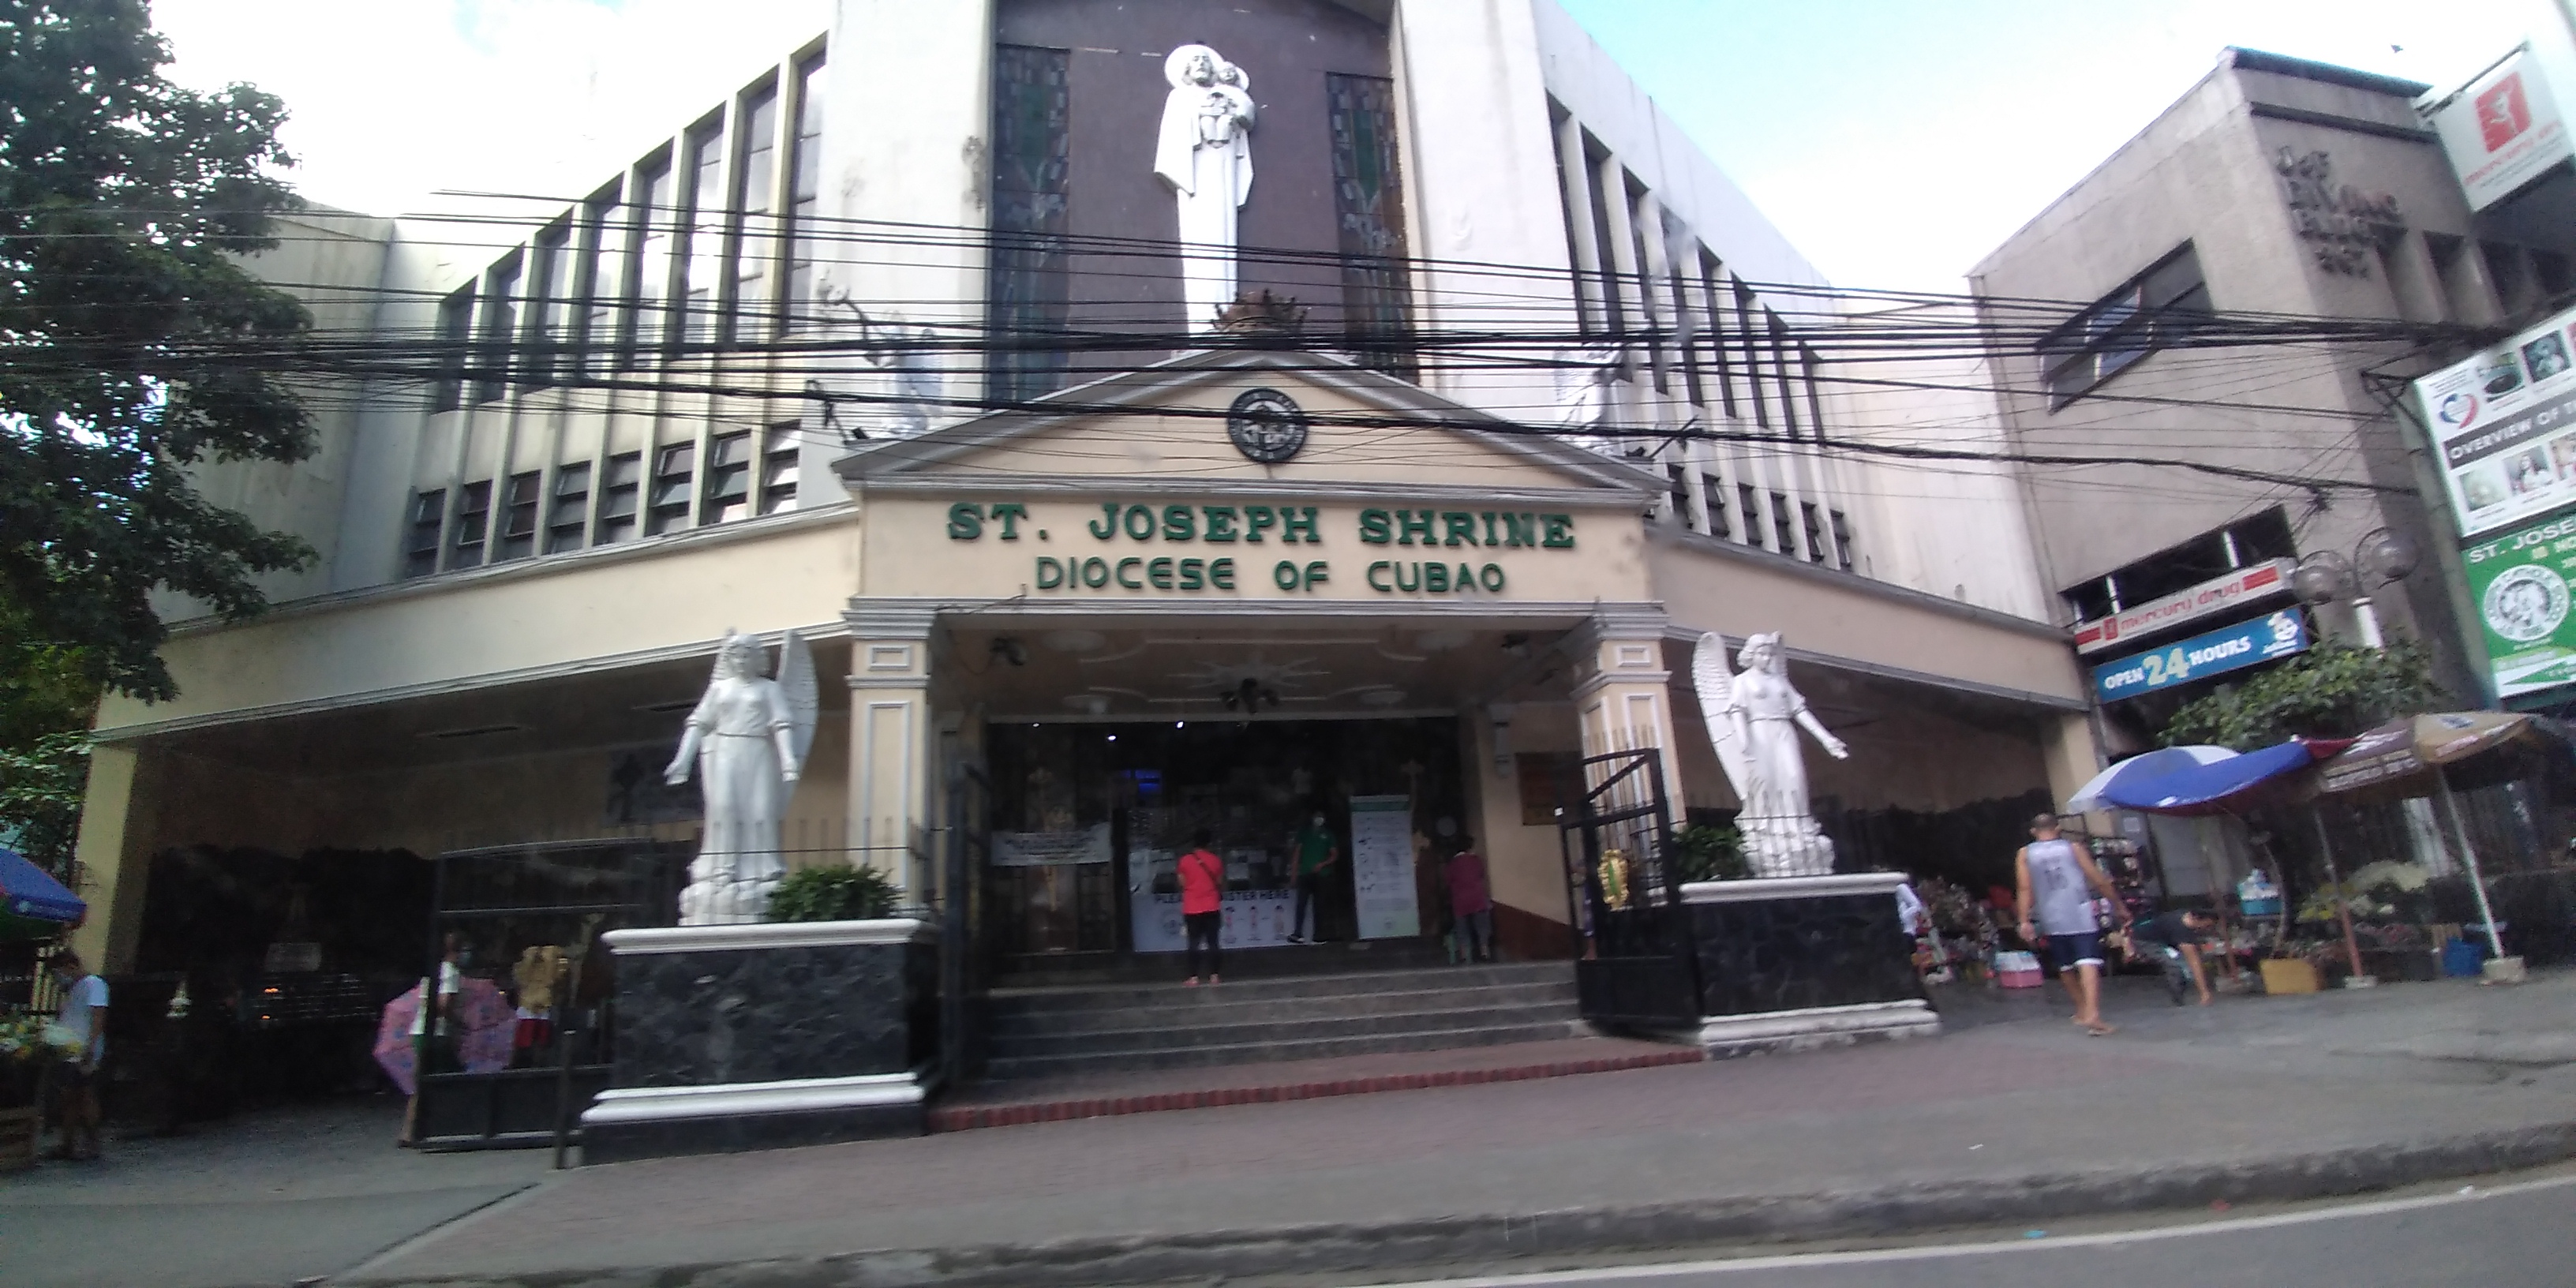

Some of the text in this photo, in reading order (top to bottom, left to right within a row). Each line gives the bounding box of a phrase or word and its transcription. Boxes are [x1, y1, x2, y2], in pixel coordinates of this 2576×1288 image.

[2450, 418, 2532, 460] OVERVIEW
[2537, 407, 2558, 425] OF
[948, 502, 1576, 549] ST. JOSEPH SHRINE
[1036, 556, 1504, 593] DIOCESE OF CUBAO
[2469, 545, 2507, 564] ST.
[2121, 597, 2192, 630] mercury
[2198, 581, 2240, 605] drug
[2104, 666, 2145, 690] OPEN
[2142, 646, 2190, 686] 24
[2188, 635, 2252, 666] HOURS
